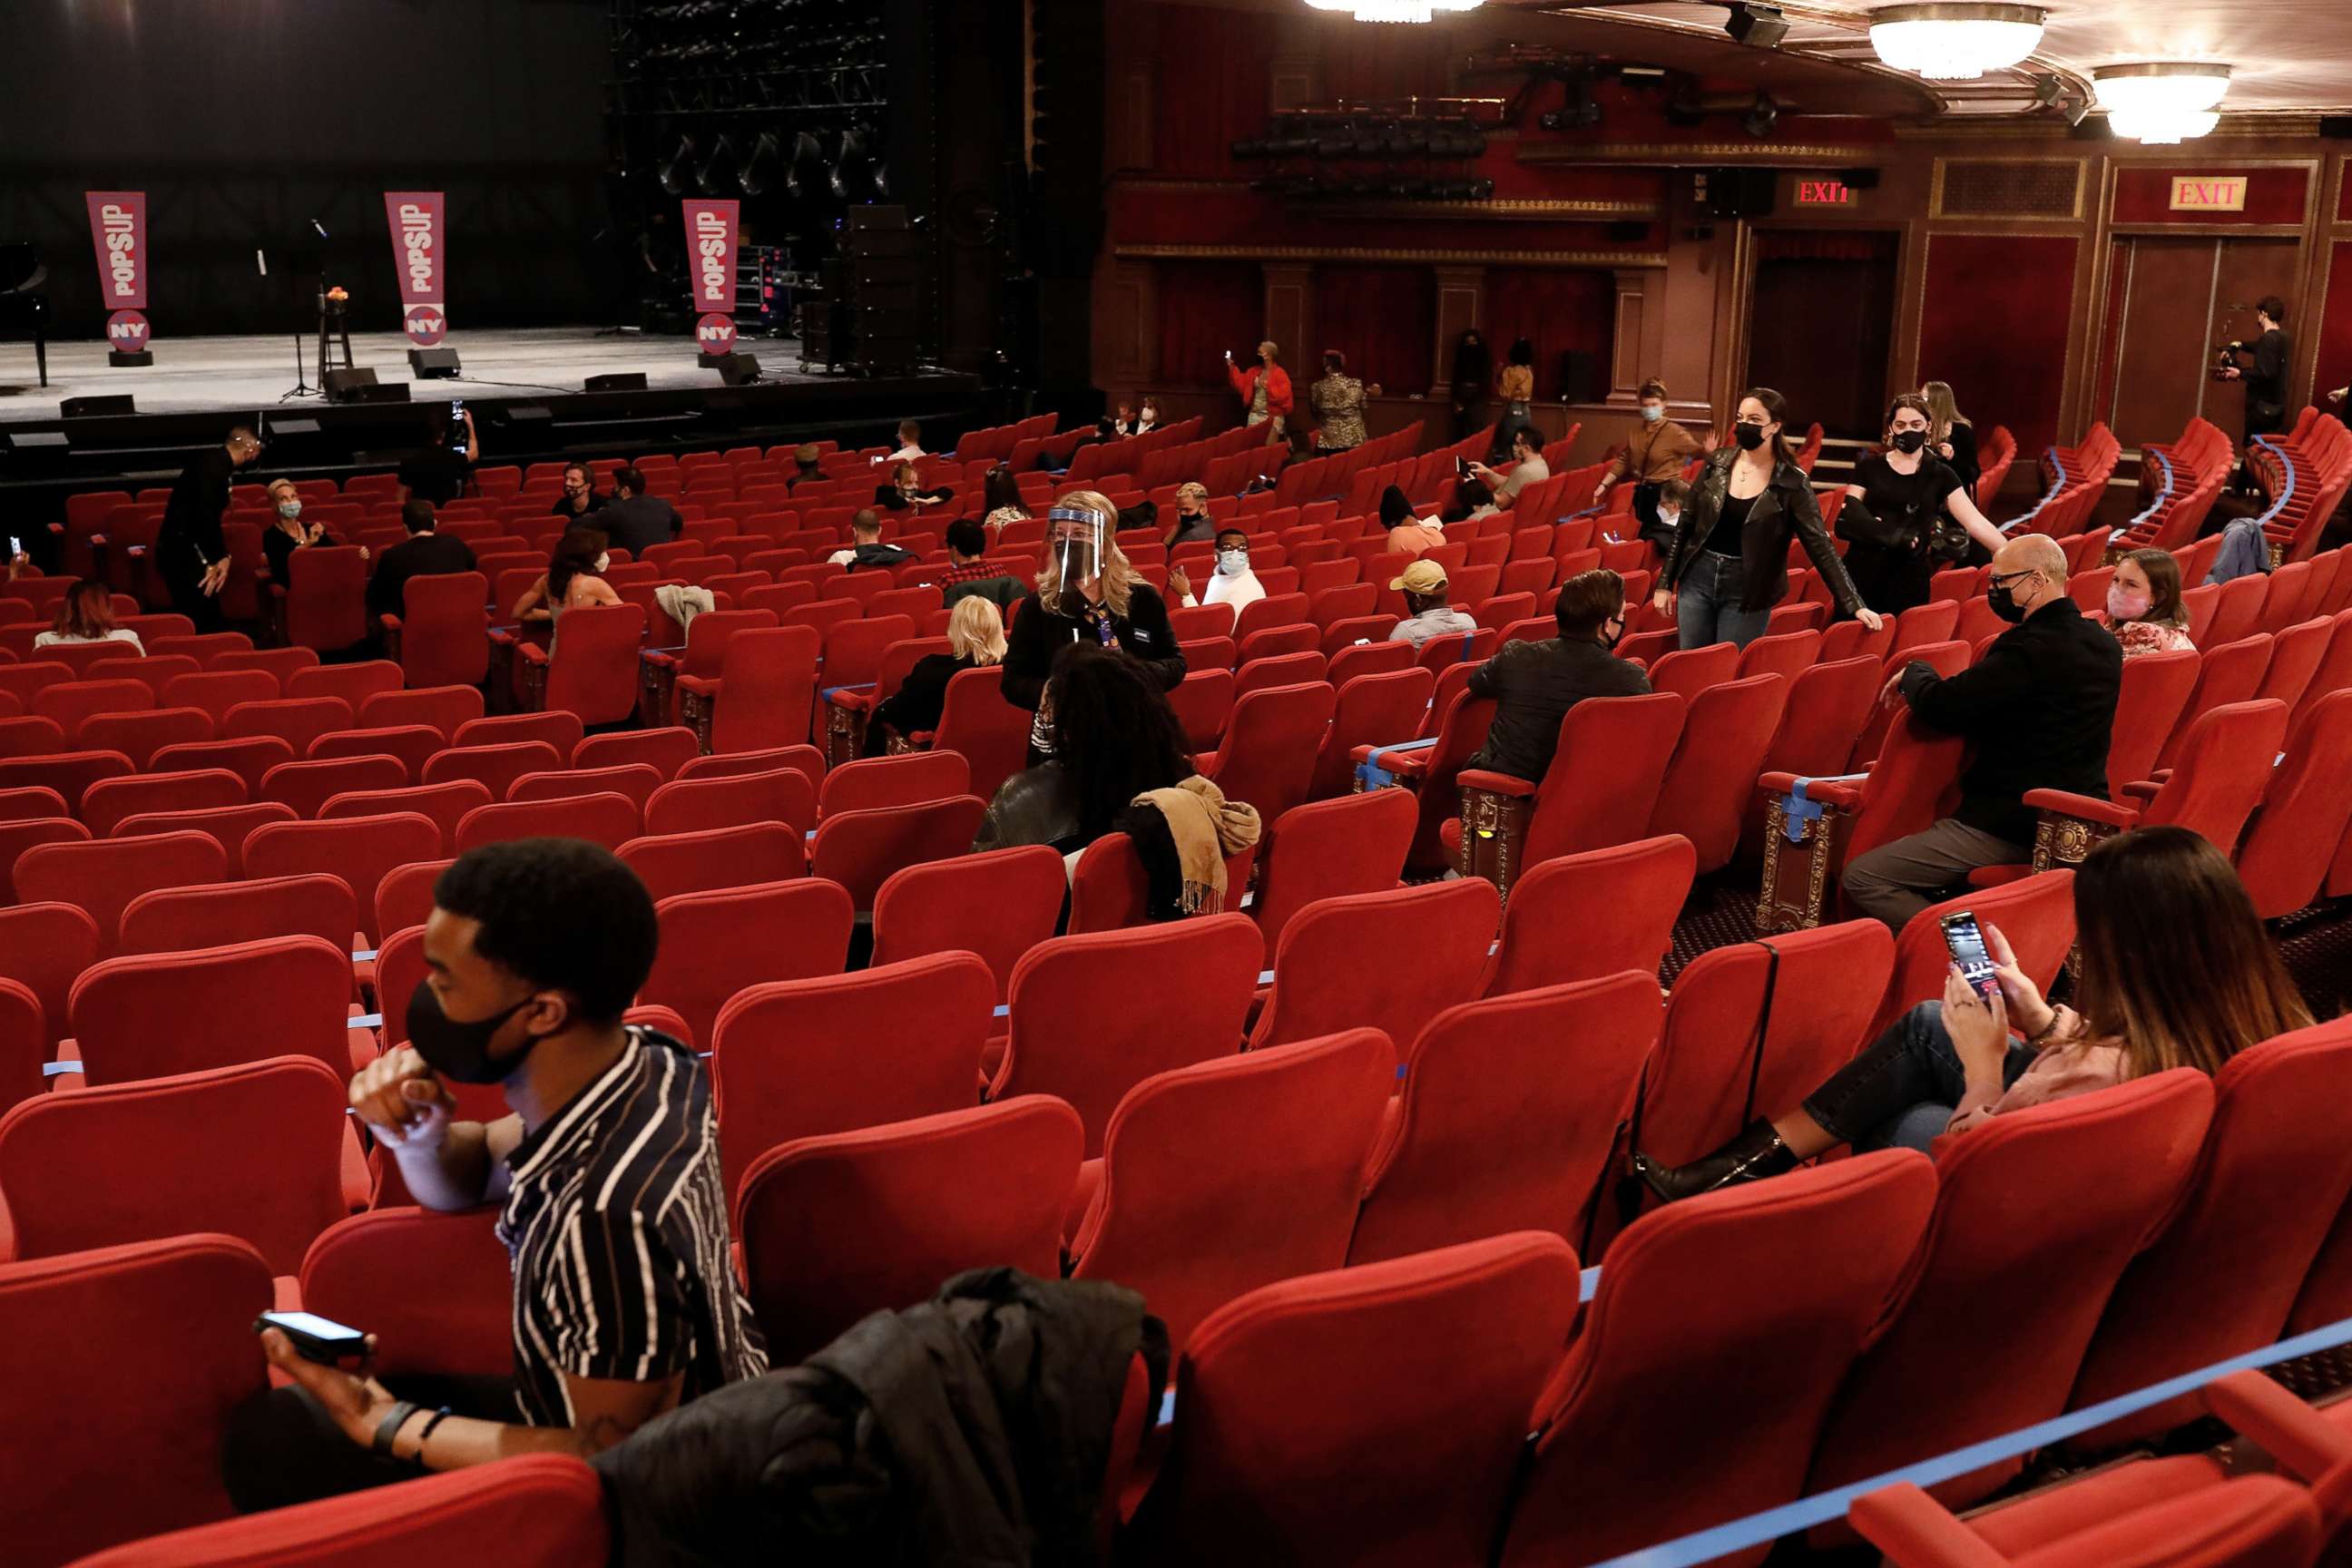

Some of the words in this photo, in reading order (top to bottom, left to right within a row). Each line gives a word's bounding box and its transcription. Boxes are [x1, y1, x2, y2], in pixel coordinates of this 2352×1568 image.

[2179, 182, 2239, 204] EXIT
[102, 204, 135, 296] POPSUP
[399, 204, 433, 292] POPSUP
[696, 211, 727, 300] POPSUP
[111, 323, 145, 338] NY
[407, 318, 443, 333] NY
[699, 326, 733, 340] NY
